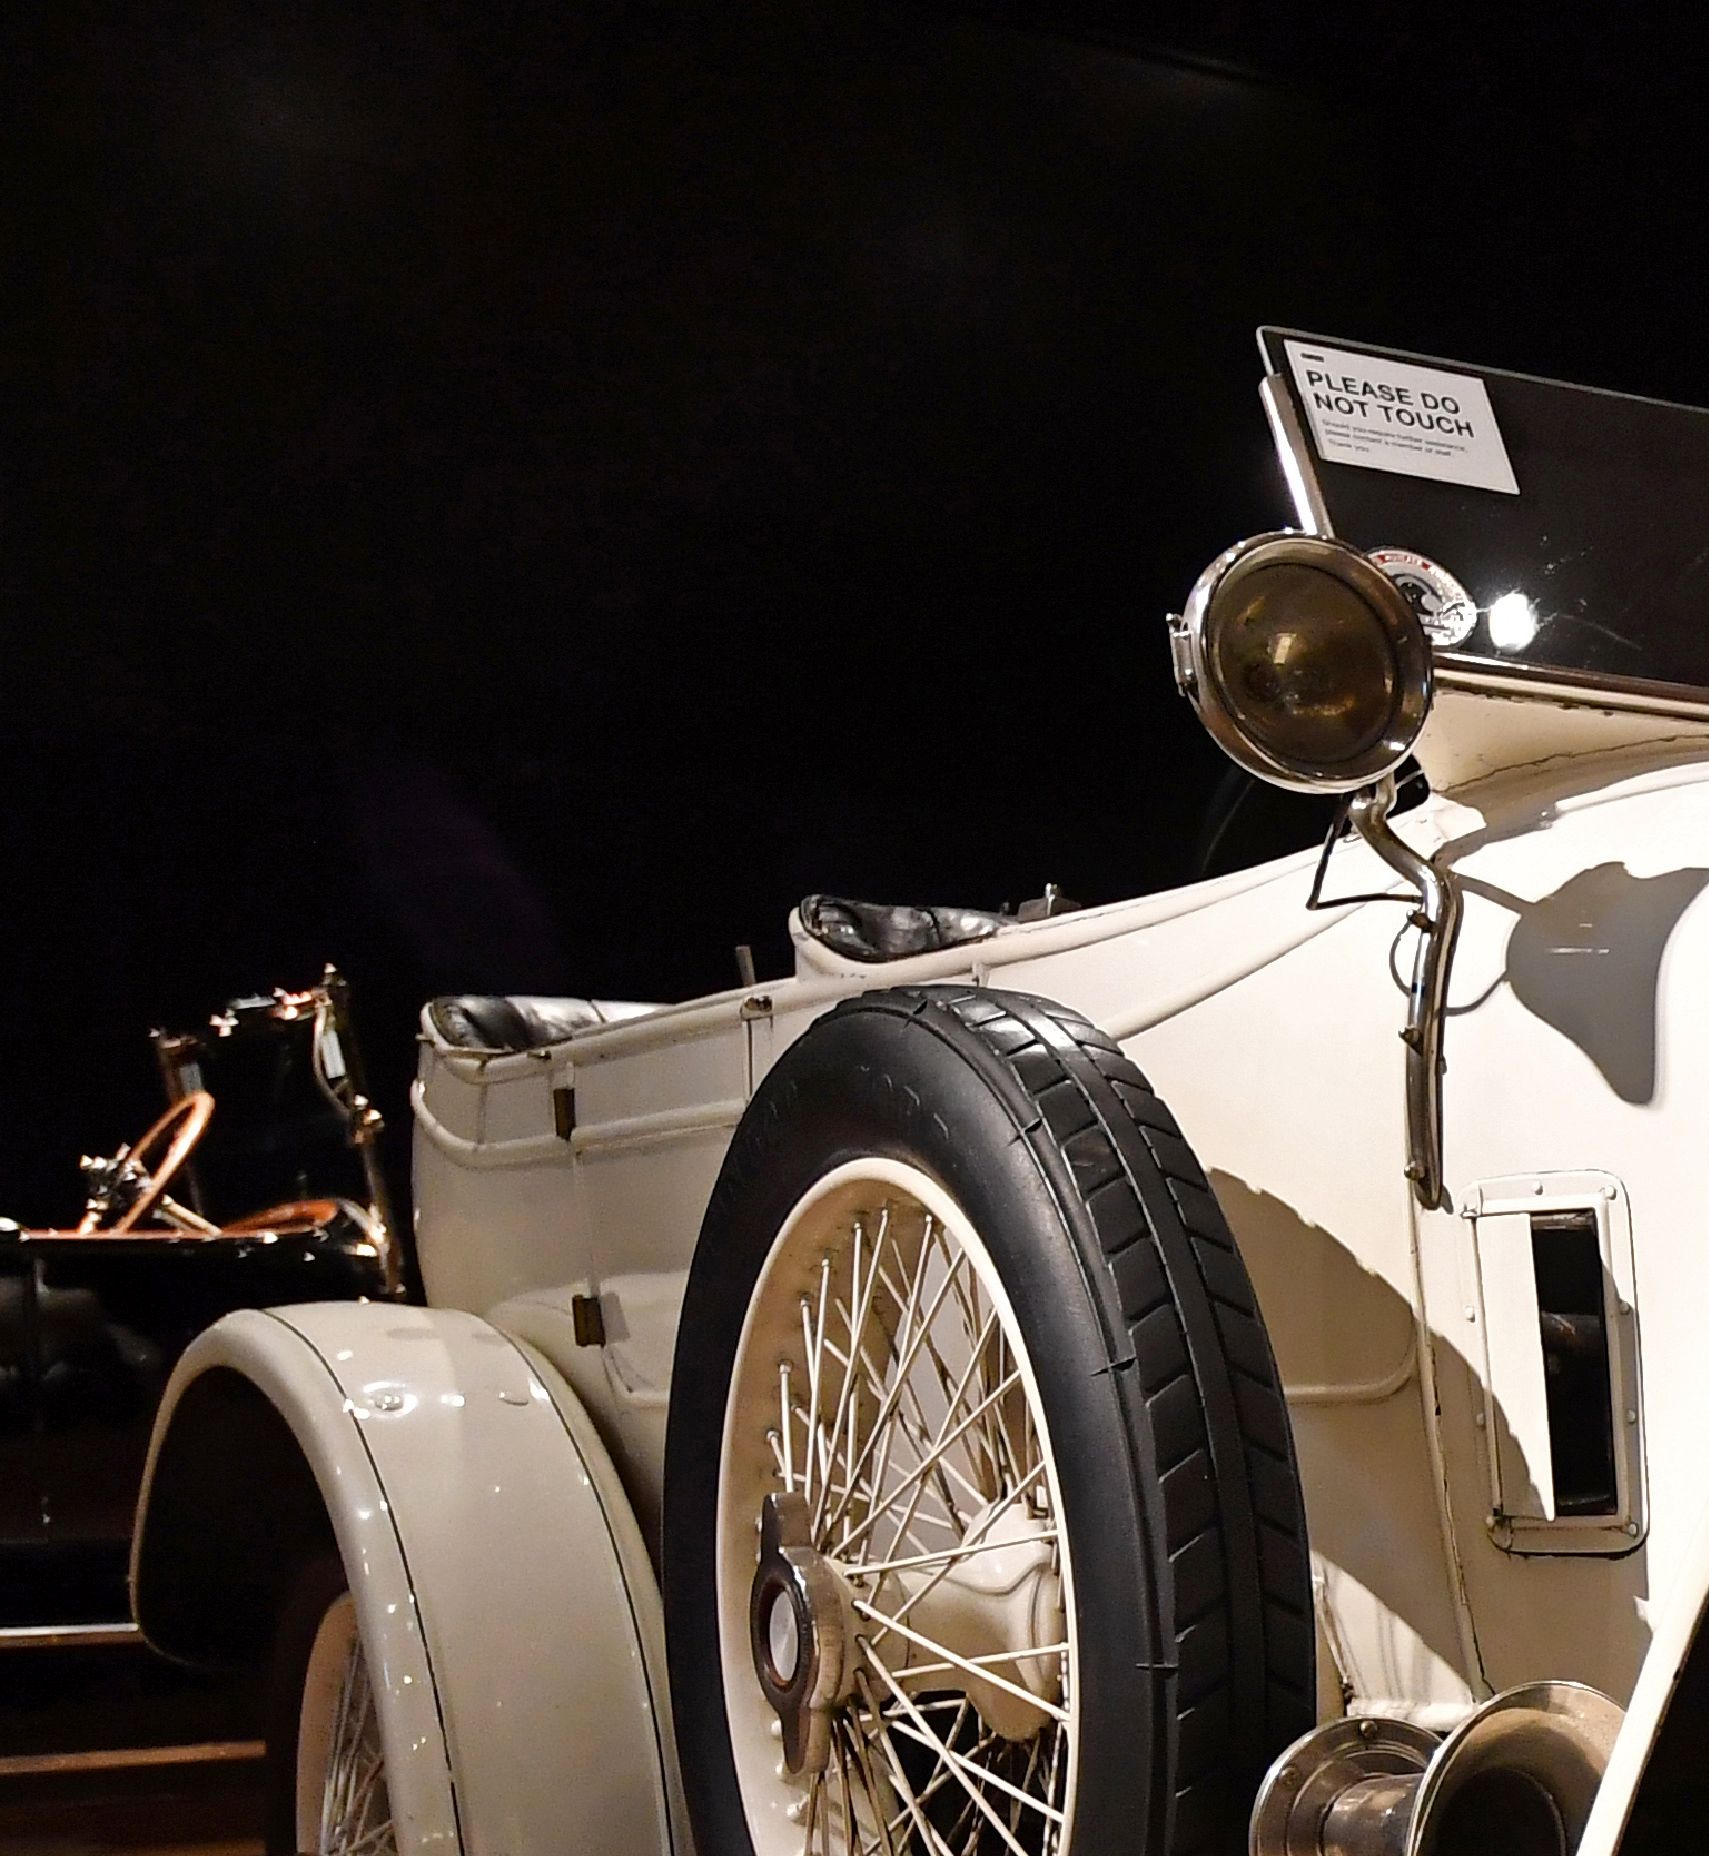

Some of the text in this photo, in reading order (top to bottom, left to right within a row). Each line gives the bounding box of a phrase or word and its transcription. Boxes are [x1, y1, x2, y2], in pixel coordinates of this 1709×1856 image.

[1306, 369, 1460, 415] PLEASE DO
[1313, 393, 1369, 418] NOT
[1377, 404, 1475, 438] TOUCH
